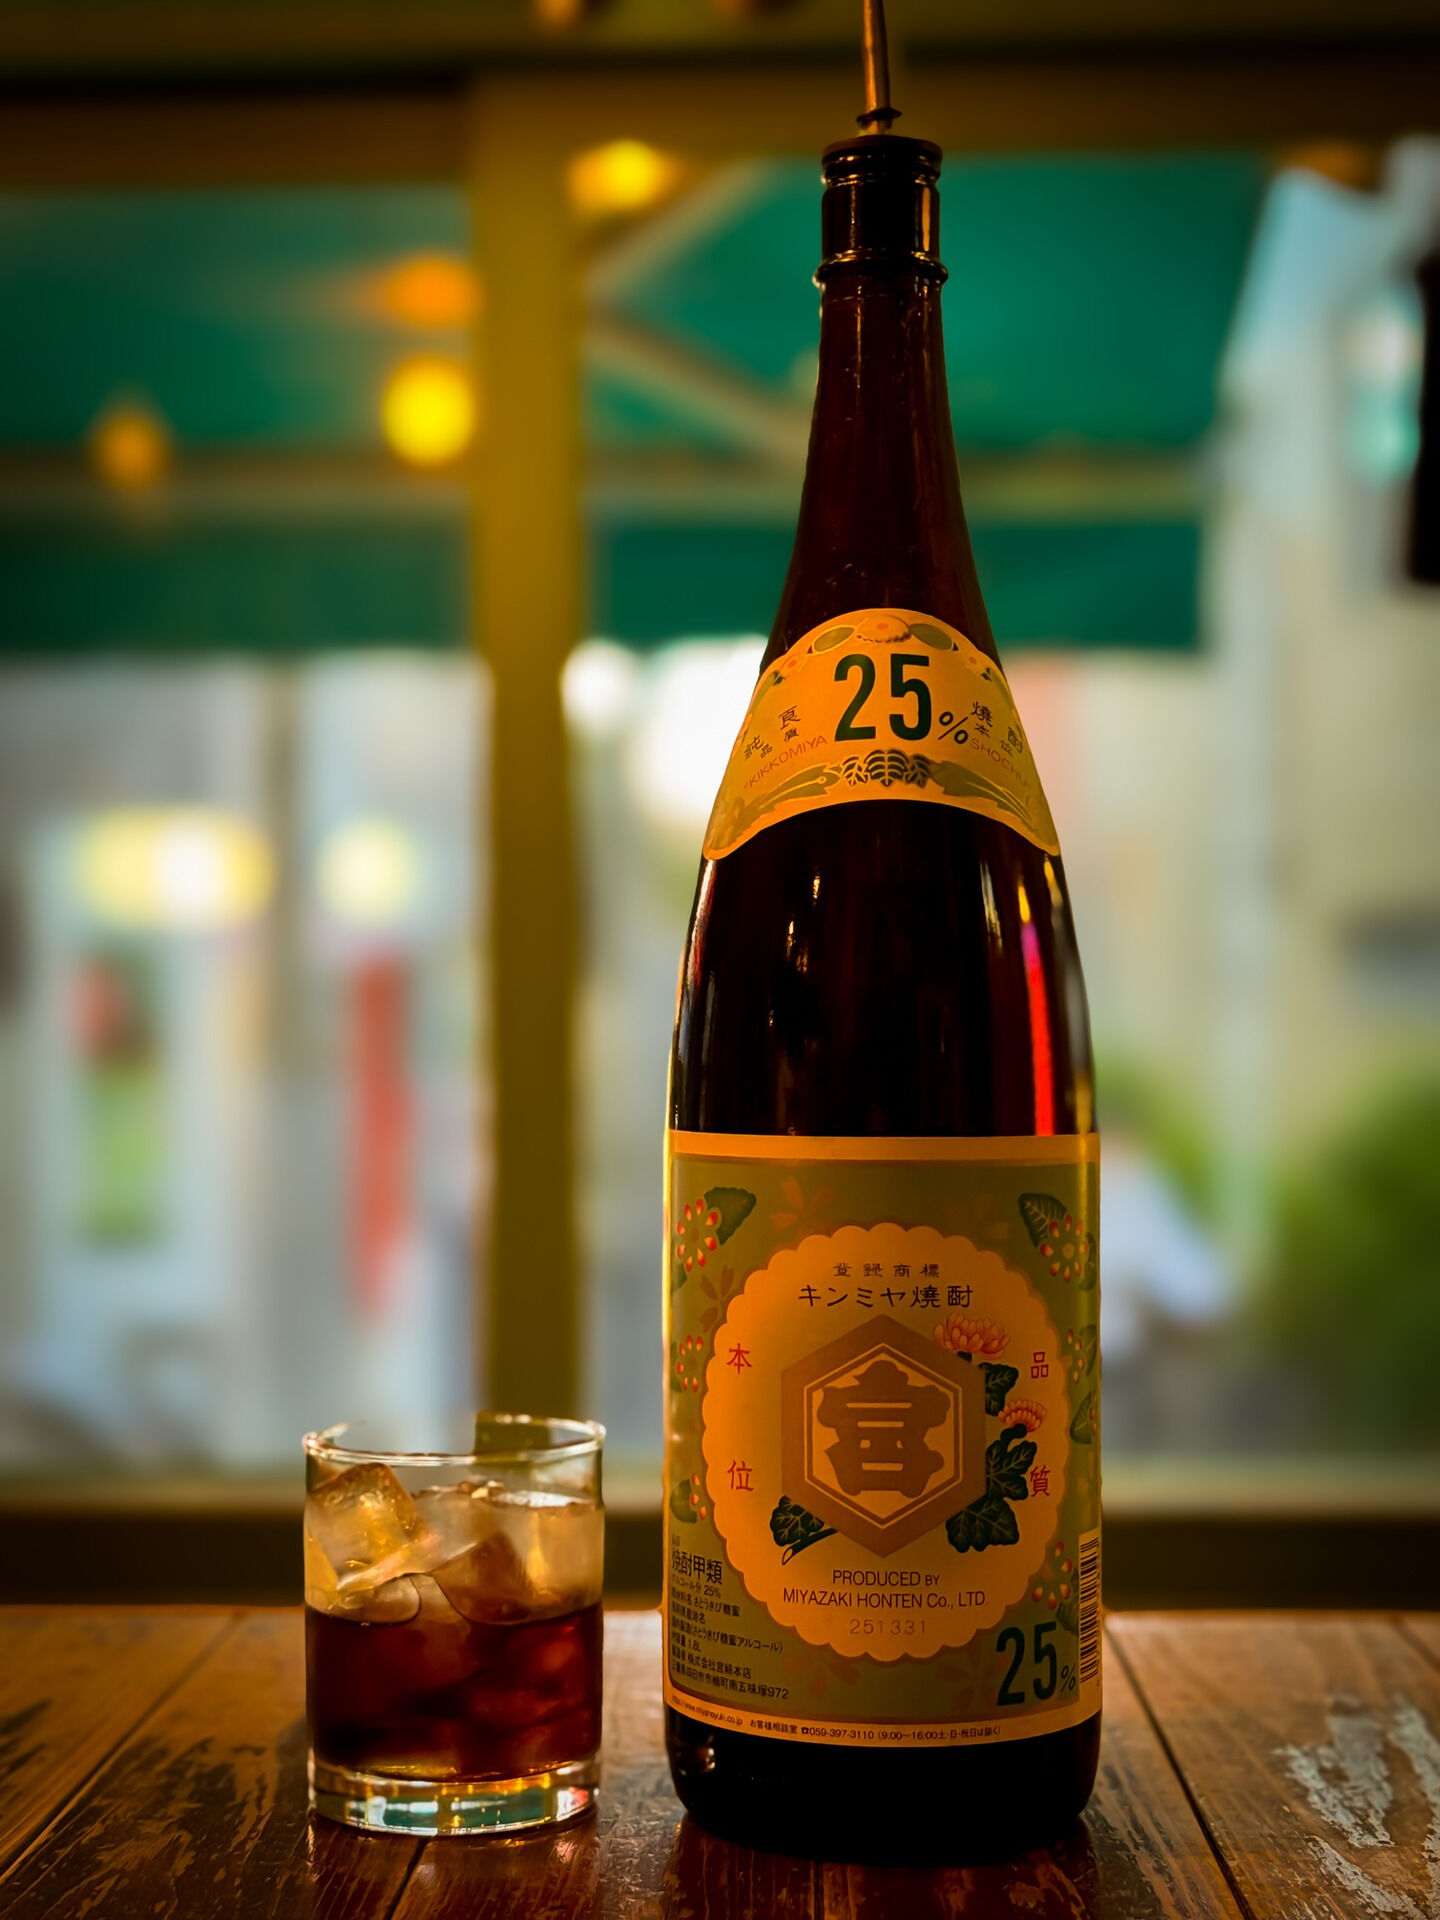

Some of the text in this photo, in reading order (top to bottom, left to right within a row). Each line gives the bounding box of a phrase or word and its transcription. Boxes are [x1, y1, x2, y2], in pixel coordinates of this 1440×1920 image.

[834, 654, 968, 745] 25%
[832, 1569, 941, 1587] PRODUCED BY
[783, 1587, 852, 1608] MIYAZAKI
[857, 1592, 923, 1609] HONTEN
[926, 1592, 954, 1610] Co.,
[849, 1618, 926, 1636] 251331
[996, 1620, 1076, 1707] 25%
